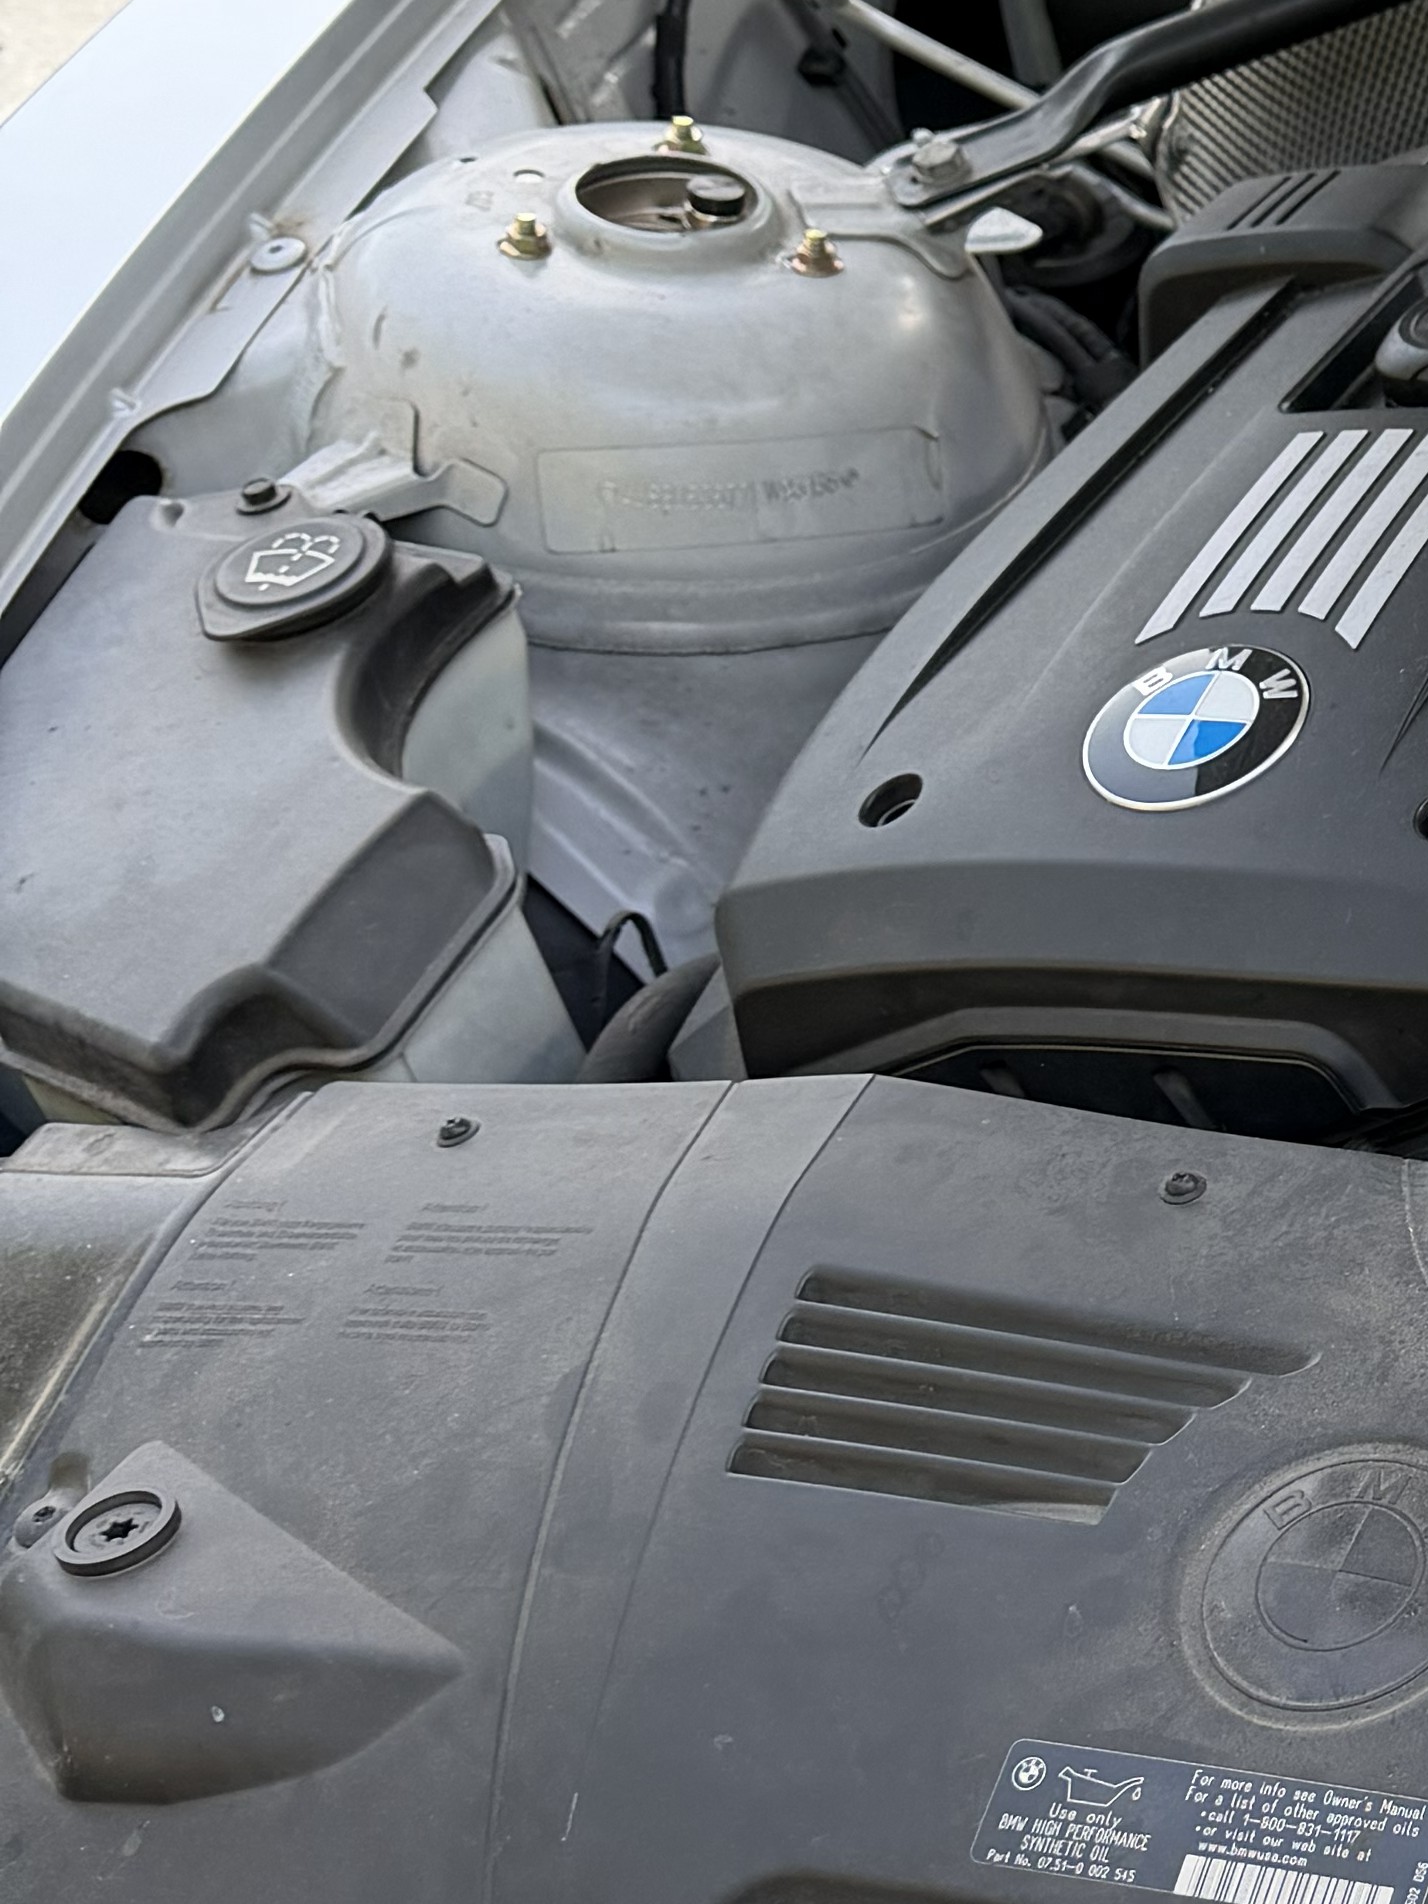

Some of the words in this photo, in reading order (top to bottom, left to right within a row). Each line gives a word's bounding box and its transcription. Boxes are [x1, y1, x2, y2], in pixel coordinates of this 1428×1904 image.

[1133, 646, 1299, 703] BMW
[1192, 1769, 1215, 1786] For
[1220, 1778, 1253, 1792] more
[1260, 1781, 1286, 1798] info
[1293, 1789, 1316, 1803] see
[1323, 1790, 1373, 1812] Owner's
[1379, 1799, 1427, 1820] Manual
[1050, 1802, 1077, 1821] Use
[1086, 1810, 1122, 1832] only
[1185, 1785, 1209, 1803] For
[1215, 1795, 1223, 1806] a
[1230, 1792, 1256, 1810] list
[1262, 1798, 1279, 1813] of
[1284, 1802, 1320, 1821] other
[1326, 1812, 1388, 1832] approved
[1393, 1821, 1420, 1838] oils
[998, 1813, 1029, 1832] BMW
[1031, 1818, 1062, 1837] HIGH
[1065, 1824, 1152, 1851] PERFORMANCE
[1243, 1813, 1361, 1844] 1-800-831-1117
[1020, 1834, 1087, 1859] SYNTHETIC
[1089, 1846, 1110, 1863] OIL
[1198, 1841, 1308, 1867] www.bmwusa.com
[1225, 1828, 1256, 1843] visit
[1262, 1836, 1284, 1847] our
[1291, 1839, 1316, 1853] web
[1324, 1844, 1349, 1859] site
[1357, 1848, 1372, 1862] at
[986, 1848, 1011, 1863] Part
[1014, 1853, 1032, 1867] No.
[1088, 1865, 1110, 1879] 002
